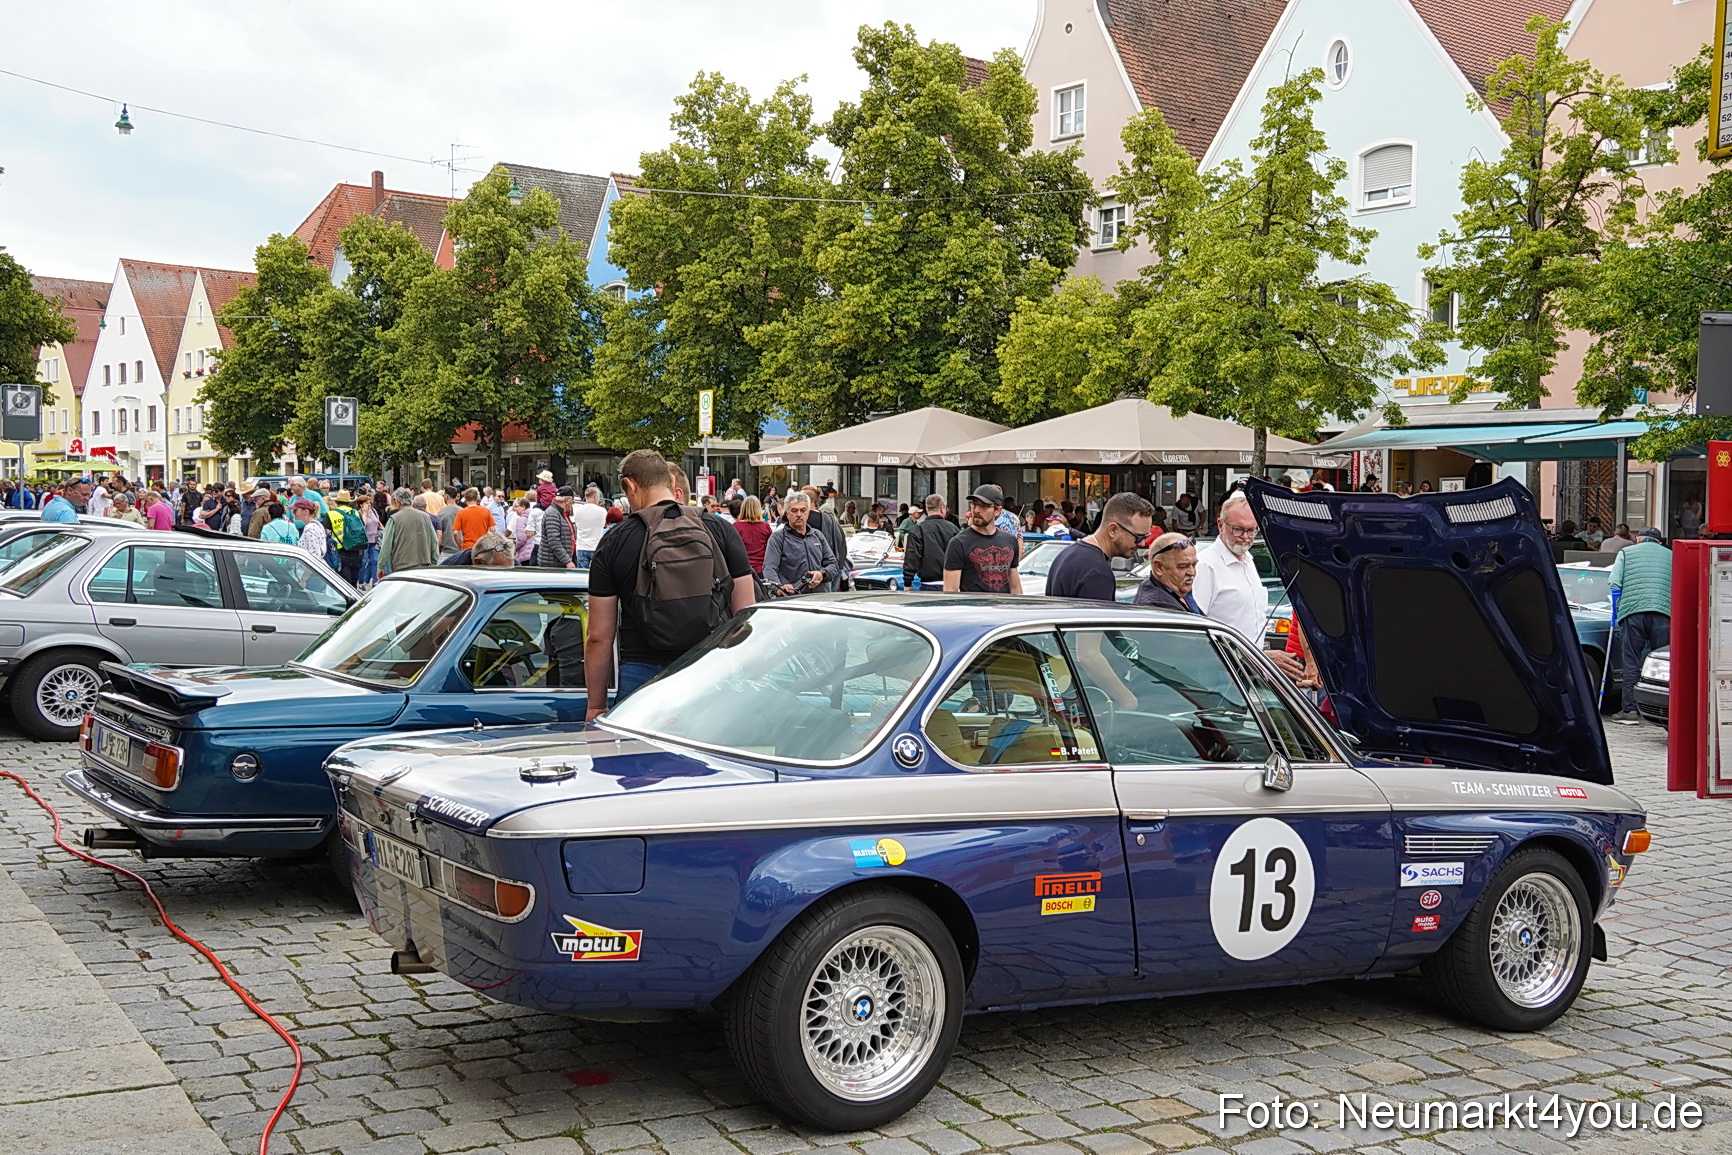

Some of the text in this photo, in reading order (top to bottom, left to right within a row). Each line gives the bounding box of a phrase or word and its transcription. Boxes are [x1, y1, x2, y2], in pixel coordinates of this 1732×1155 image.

[1451, 781, 1485, 795] TEAM
[1491, 783, 1552, 798] SCHNITZER
[1559, 787, 1586, 797] MOTUL
[424, 796, 489, 827] SCHNITZER
[377, 836, 389, 870] HI
[852, 849, 878, 857] BILSTEIN
[1421, 867, 1463, 877] SACHS
[1035, 872, 1102, 896] PIRELLI
[1230, 846, 1296, 932] 13
[1045, 901, 1073, 911] BOSCH
[1422, 892, 1439, 905] STP
[561, 937, 622, 952] motul
